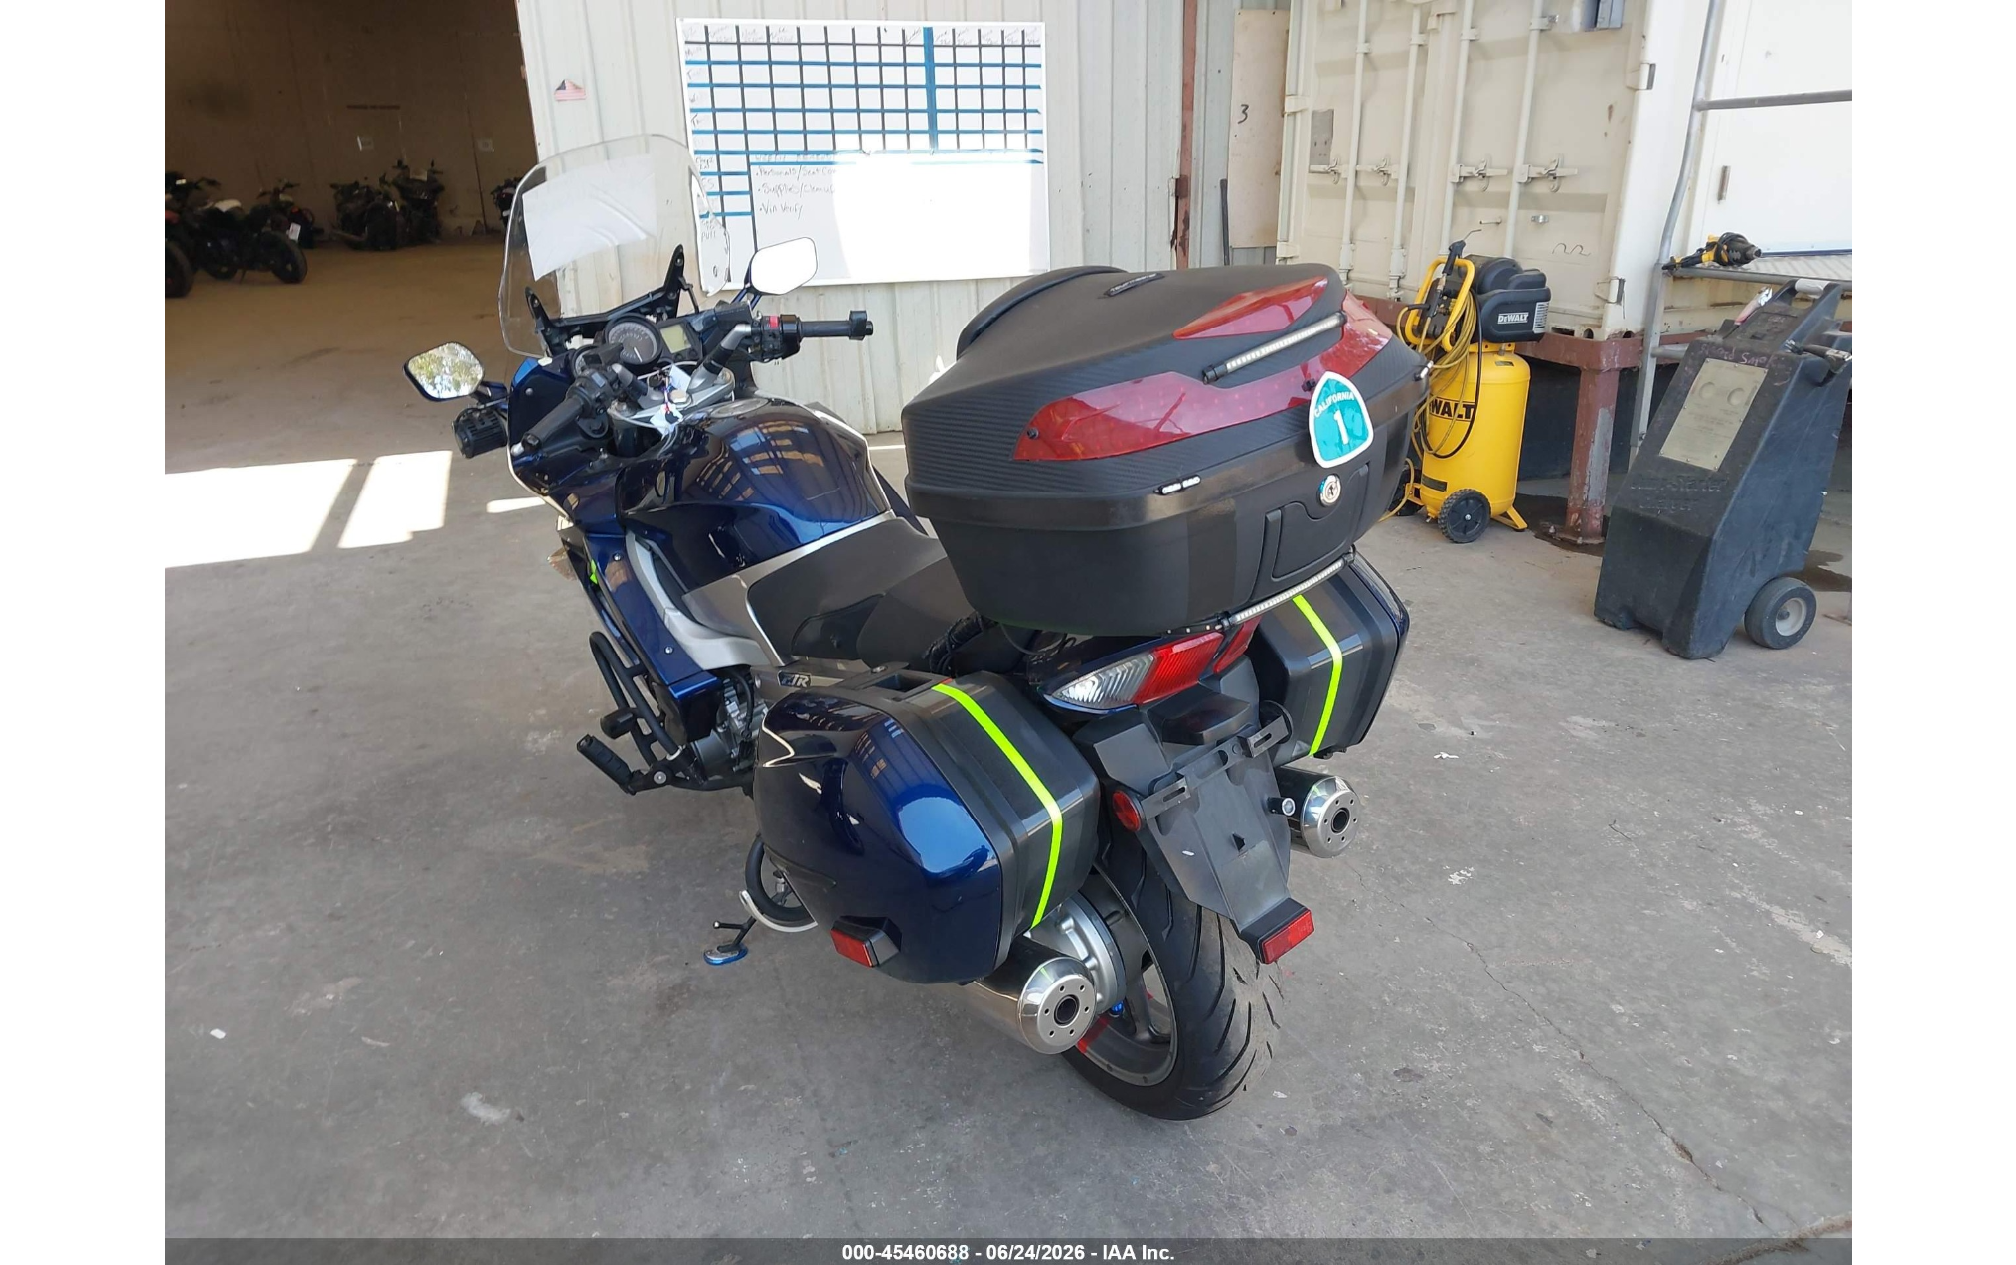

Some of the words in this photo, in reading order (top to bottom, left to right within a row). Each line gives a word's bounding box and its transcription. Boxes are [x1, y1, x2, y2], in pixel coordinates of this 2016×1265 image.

[1237, 103, 1250, 125] 3
[1314, 391, 1355, 418] CALIFORNIA
[1430, 399, 1476, 420] WALT
[1333, 409, 1349, 446] 1
